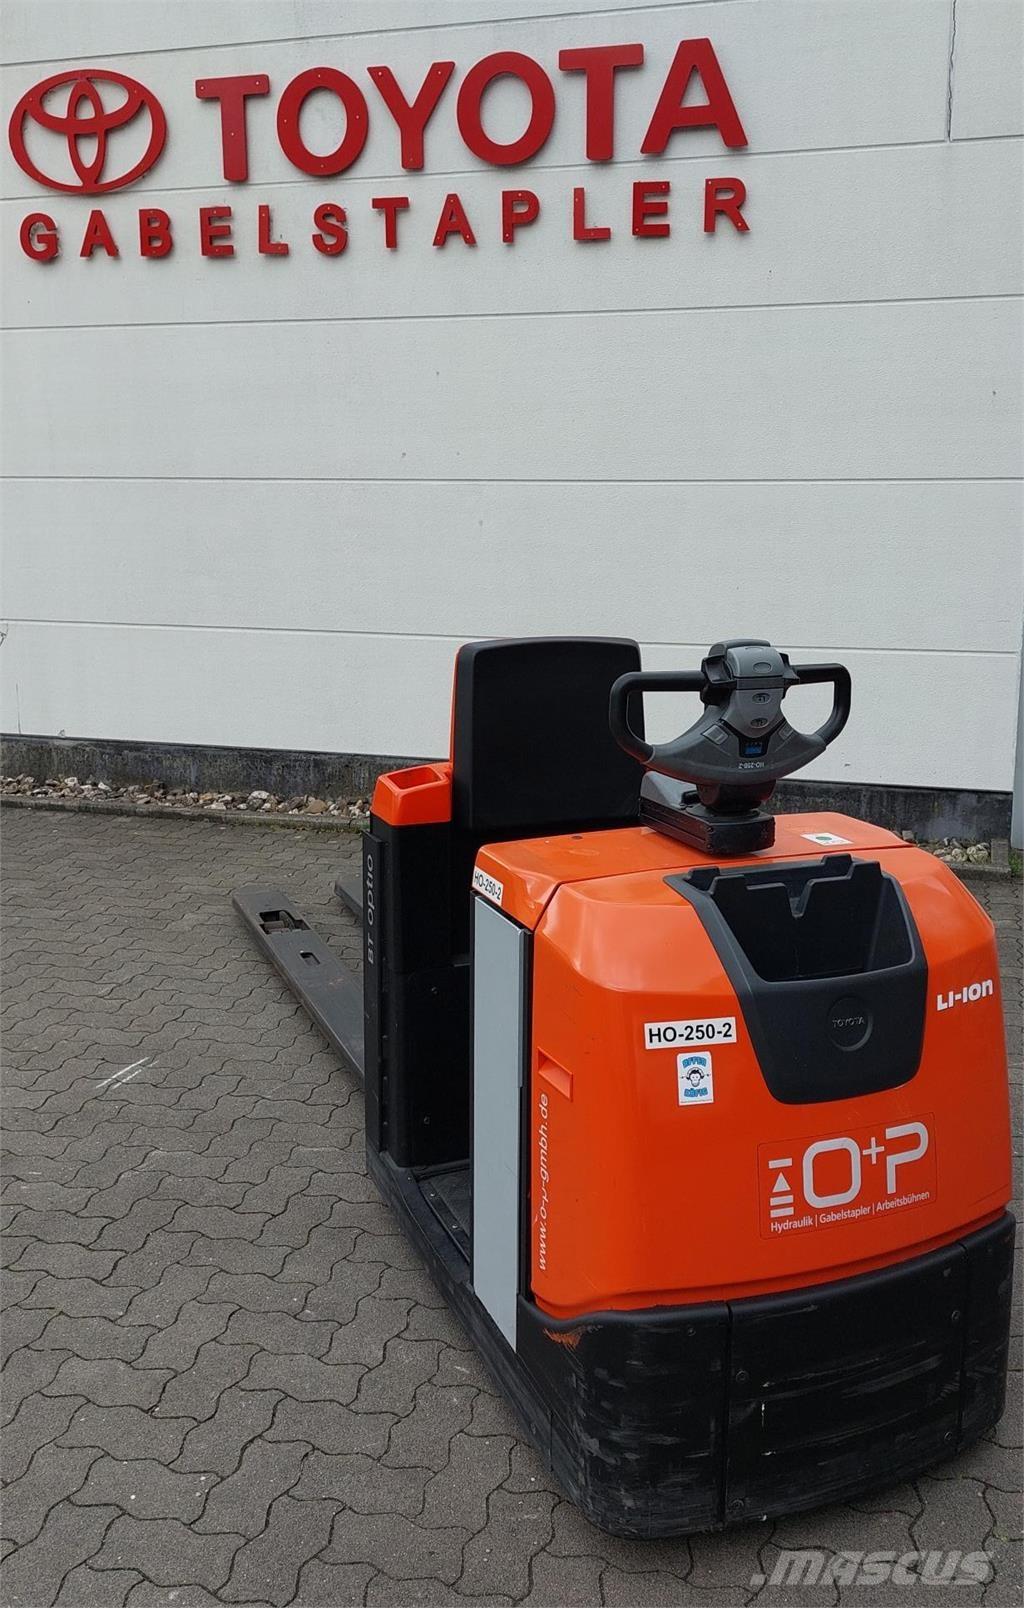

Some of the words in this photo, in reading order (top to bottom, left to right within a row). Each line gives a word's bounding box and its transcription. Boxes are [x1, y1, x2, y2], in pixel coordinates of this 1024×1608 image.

[195, 37, 749, 183] TOYOTA
[19, 177, 750, 263] GABELSTAPLER
[474, 870, 502, 901] HO-250-2
[367, 932, 374, 965] BT
[648, 1022, 733, 1044] HO-250-2
[832, 1016, 866, 1028] TOYOTA
[802, 1121, 929, 1209] O+P
[770, 1217, 814, 1234] Hydraulik
[819, 1205, 872, 1224] Gabelstapler
[876, 1191, 930, 1212] Arbeitsbühnen
